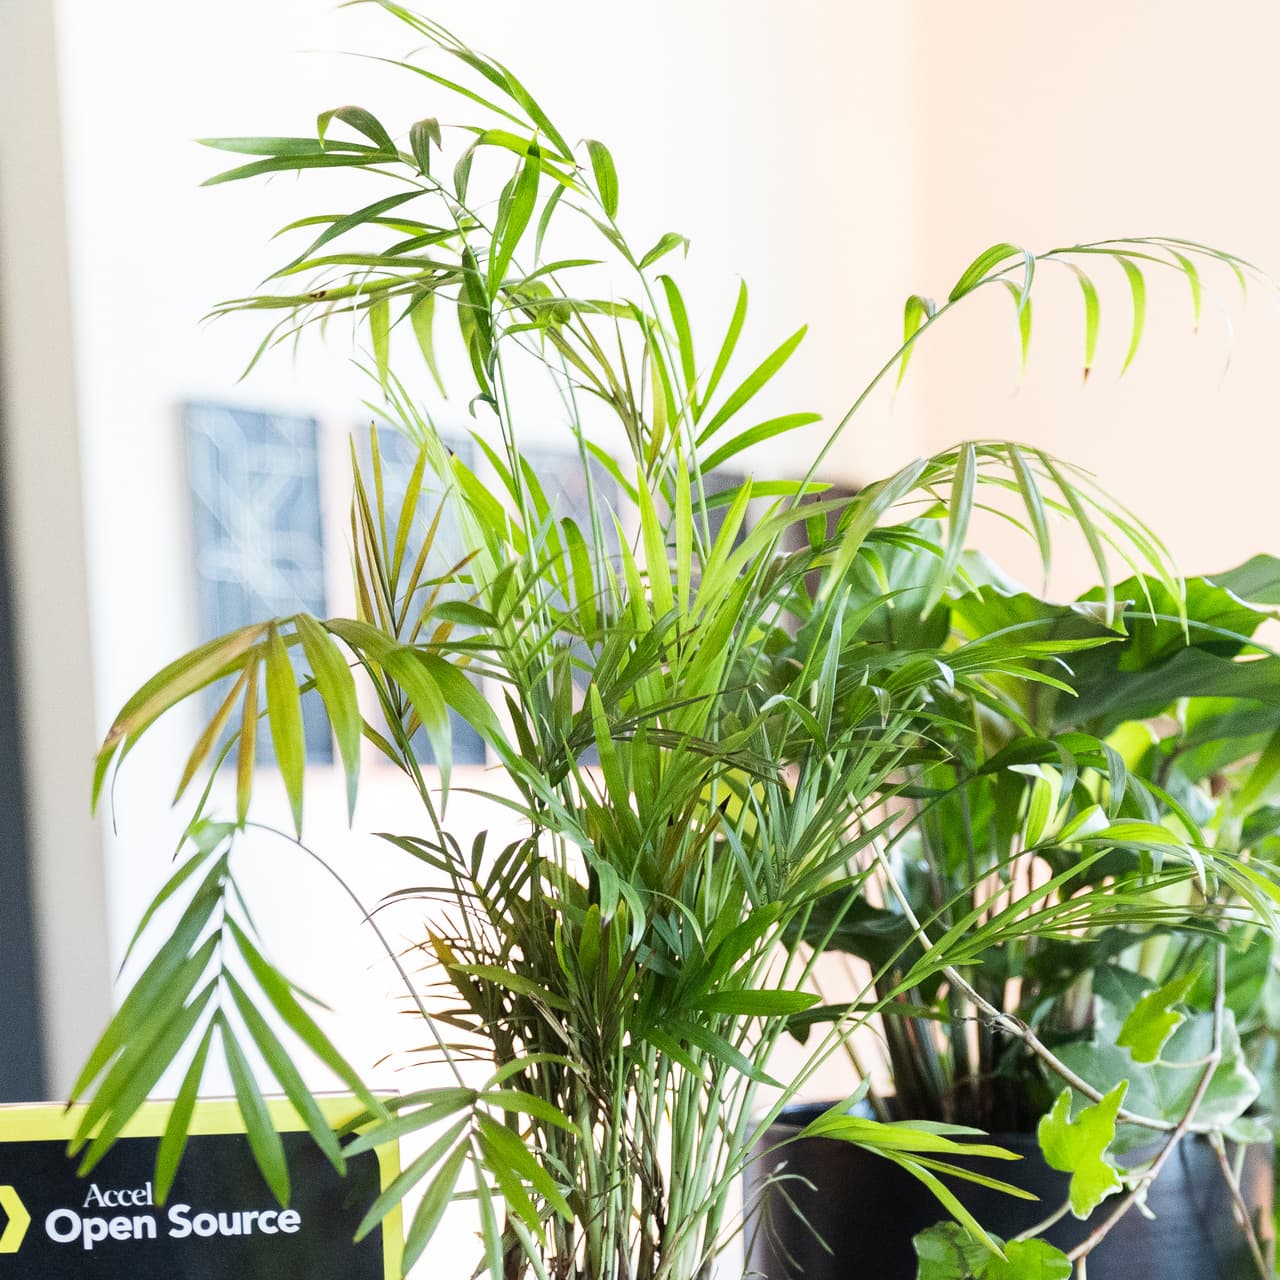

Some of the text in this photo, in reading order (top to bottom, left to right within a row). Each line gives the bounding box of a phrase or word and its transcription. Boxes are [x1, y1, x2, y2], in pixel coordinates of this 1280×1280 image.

[83, 1181, 154, 1208] Accel
[44, 1203, 301, 1250] Open Source
